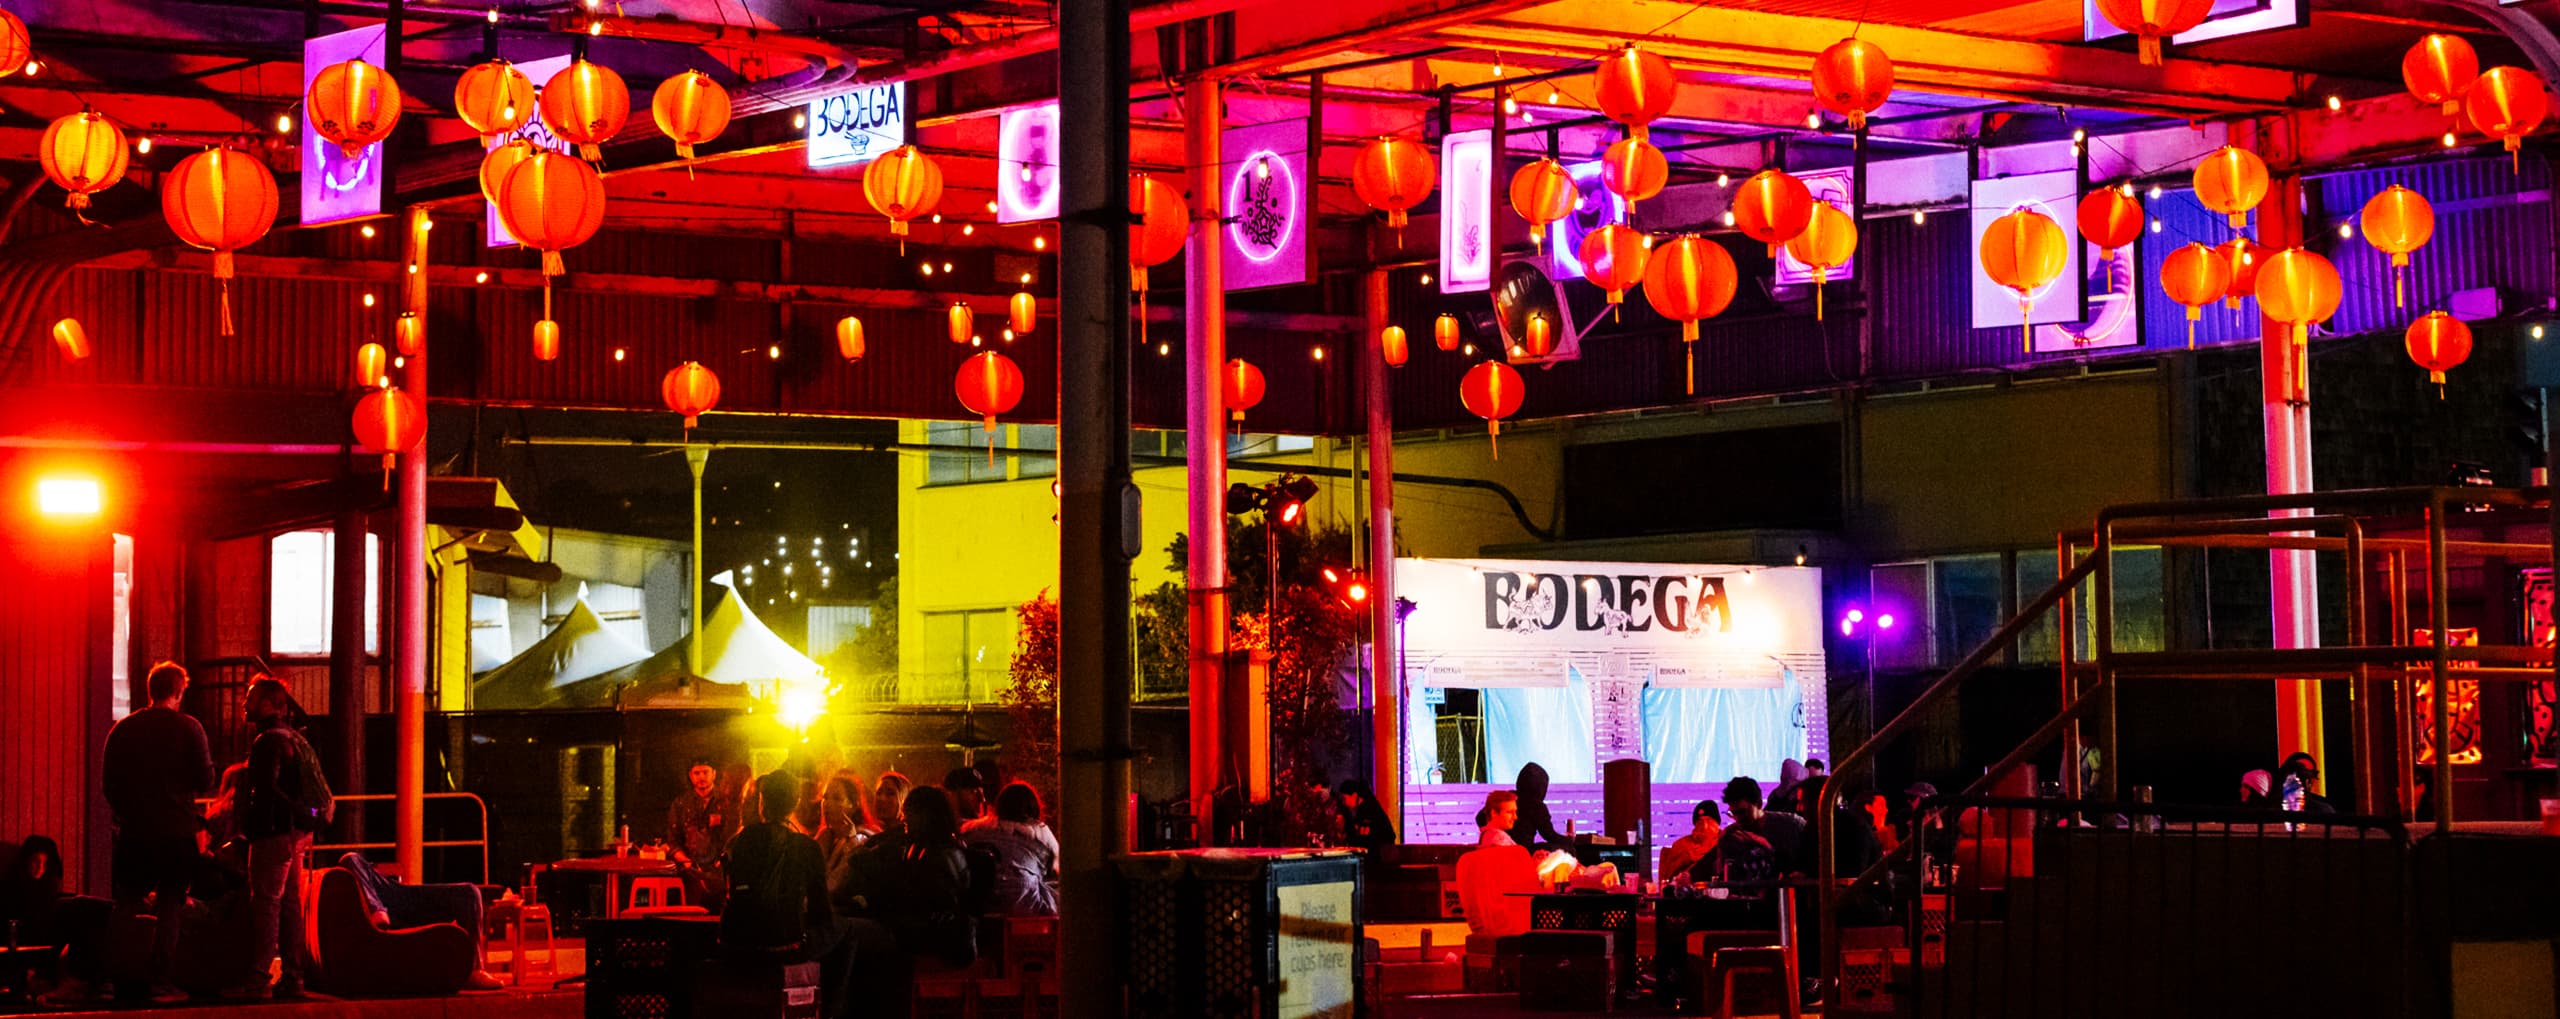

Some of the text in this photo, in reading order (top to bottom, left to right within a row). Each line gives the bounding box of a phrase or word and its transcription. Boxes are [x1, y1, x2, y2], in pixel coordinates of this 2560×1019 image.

[817, 84, 900, 137] BODEGA
[1483, 572, 1733, 633] BODEGA
[1301, 901, 1337, 921] Please
[1290, 953, 1316, 976] cups
